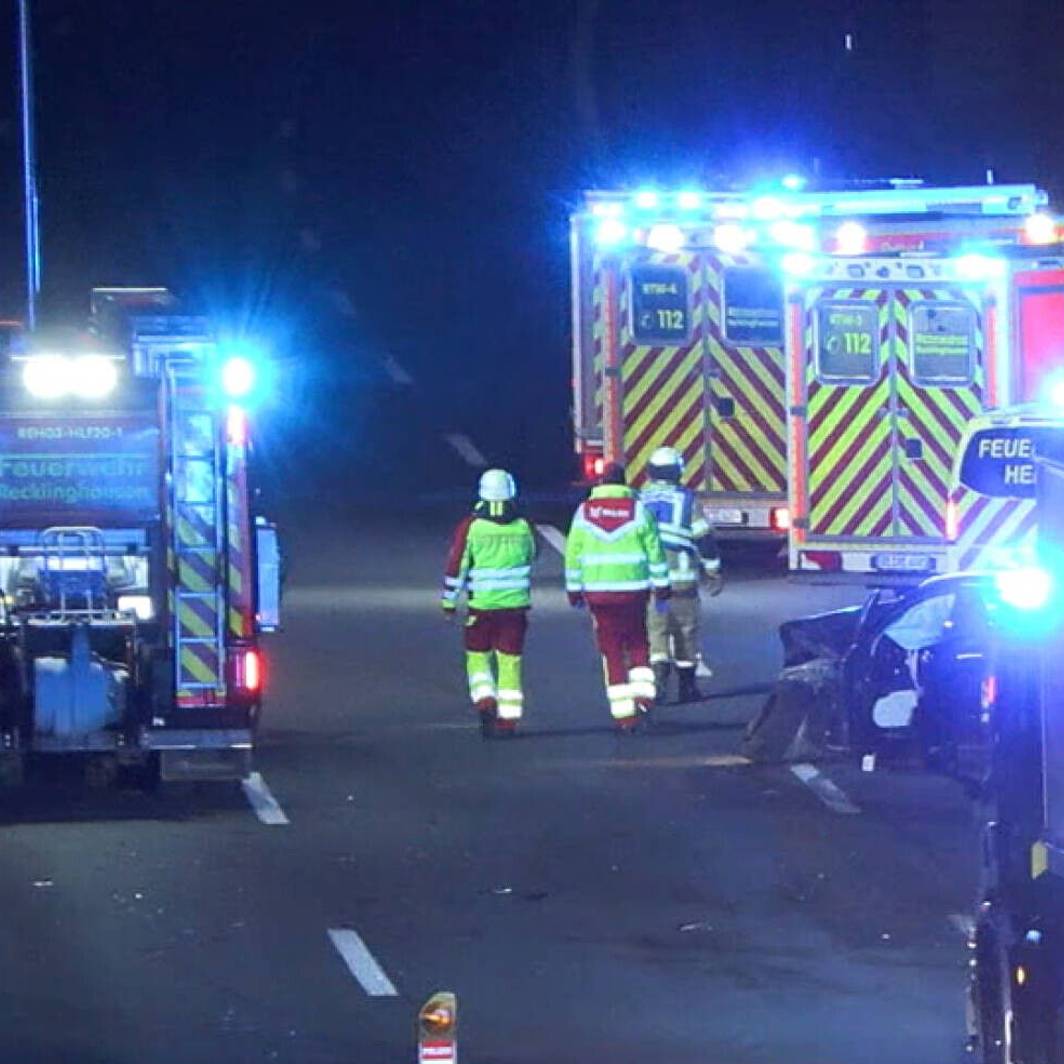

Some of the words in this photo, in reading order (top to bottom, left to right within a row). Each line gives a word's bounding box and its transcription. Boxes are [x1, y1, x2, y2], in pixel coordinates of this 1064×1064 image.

[657, 309, 684, 329] 112
[844, 332, 872, 354] 112
[978, 438, 1034, 458] FEUE
[1004, 463, 1037, 484] HE
